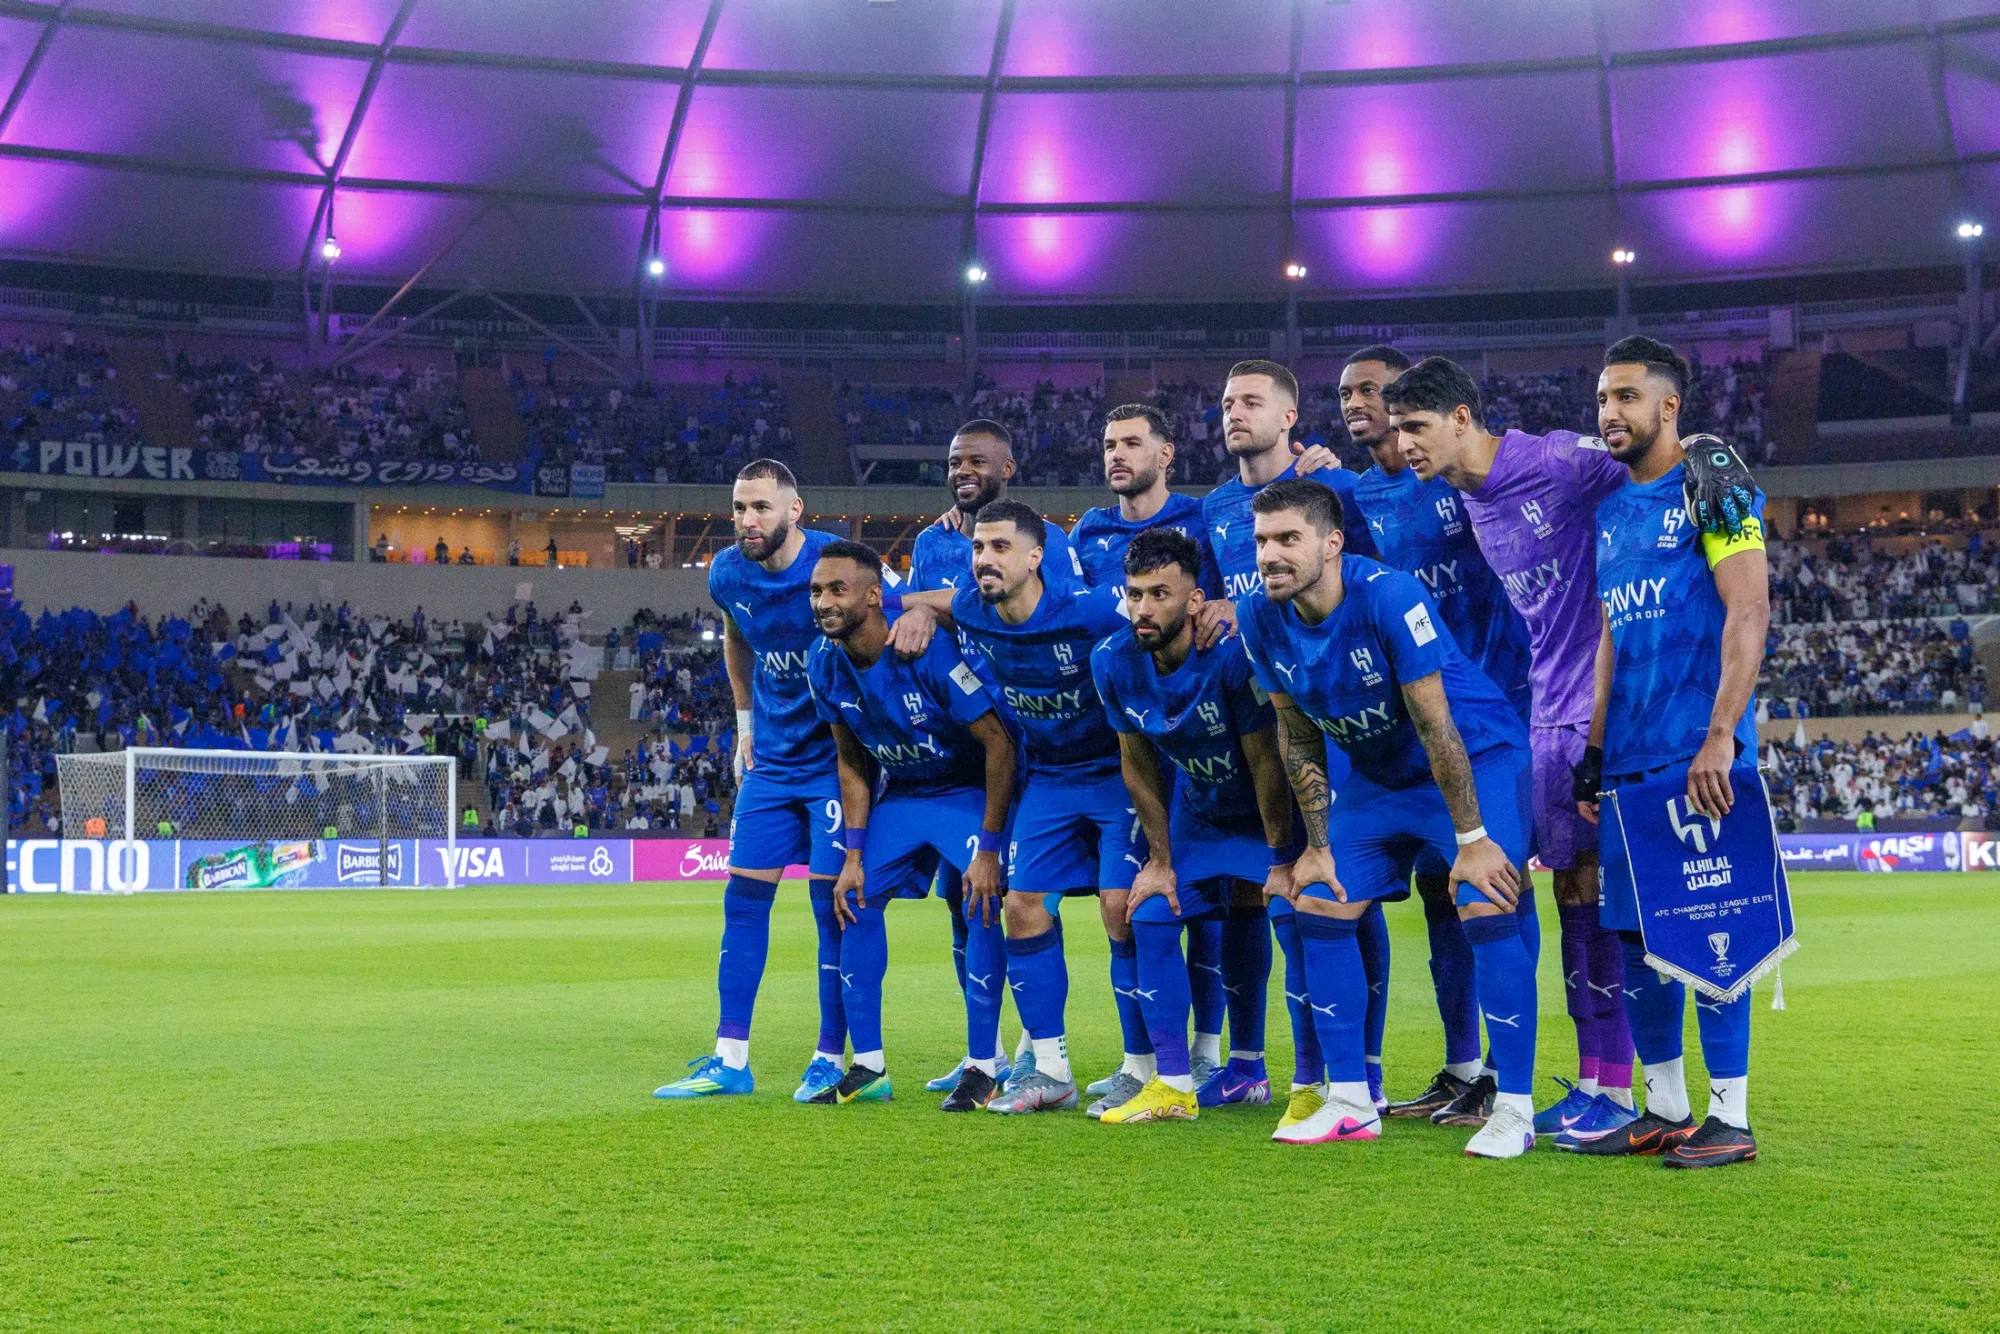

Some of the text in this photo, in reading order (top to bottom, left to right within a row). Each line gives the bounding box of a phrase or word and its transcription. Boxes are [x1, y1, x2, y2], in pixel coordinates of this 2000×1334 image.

[39, 440, 196, 480] POWER
[263, 455, 373, 483] وشعب
[460, 461, 518, 483] قوة
[1223, 571, 1262, 598] SAV
[1432, 585, 1463, 599] ROUP
[1625, 608, 1666, 622] GROUP
[1004, 686, 1080, 711] SAVVY
[825, 799, 842, 834] 9
[343, 854, 397, 870] BARBICN
[435, 847, 504, 877] VISA
[1682, 856, 1732, 875] ALHILAL
[1673, 903, 1717, 914] CHAMPIONS
[1719, 898, 1749, 909] LEAGUE
[1752, 894, 1774, 904] ELITE
[1689, 911, 1716, 921] ROUND
